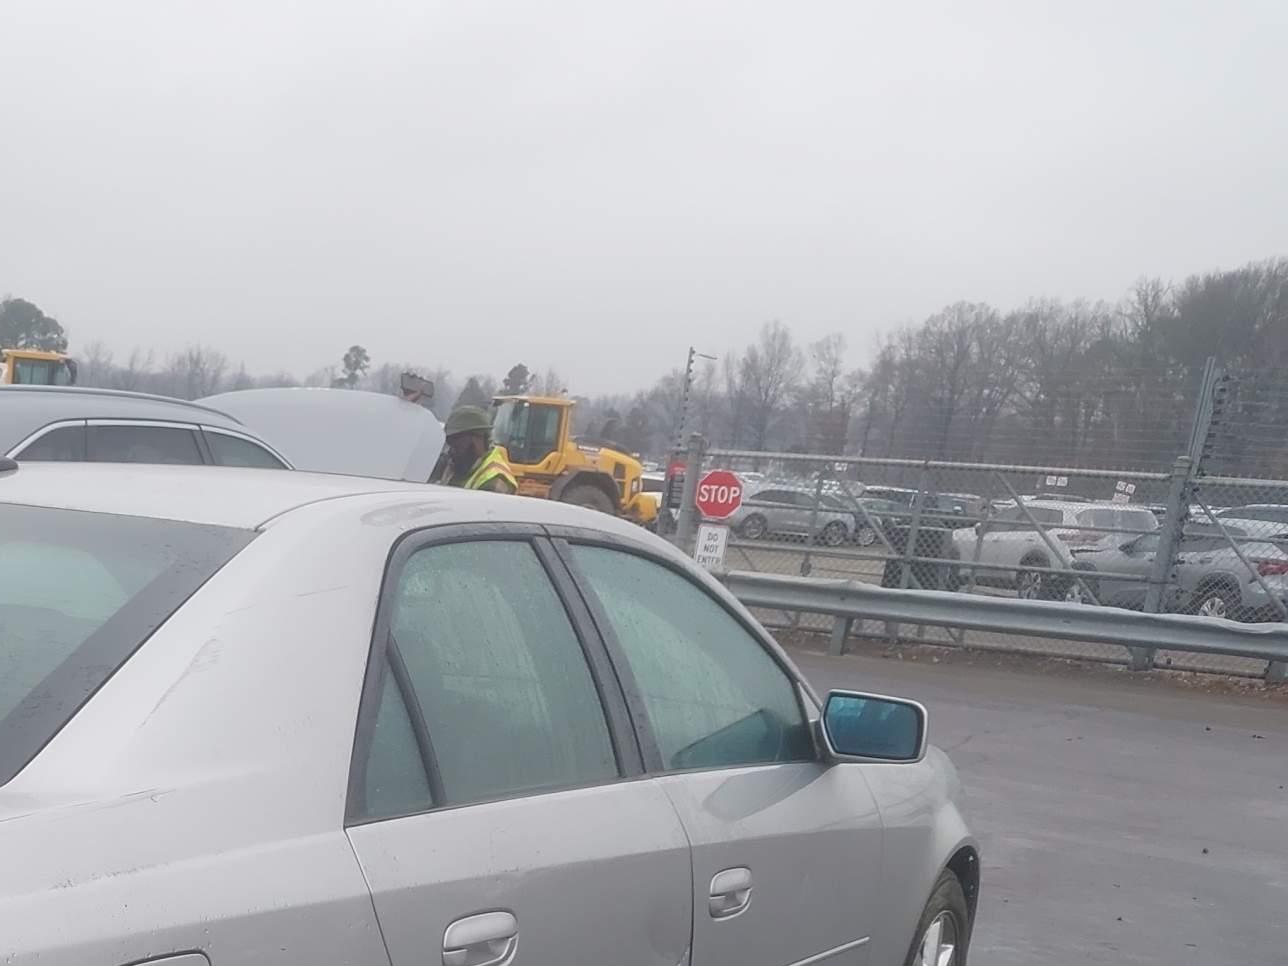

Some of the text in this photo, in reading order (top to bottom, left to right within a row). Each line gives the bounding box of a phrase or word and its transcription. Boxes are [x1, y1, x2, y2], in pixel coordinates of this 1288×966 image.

[699, 485, 740, 504] STOP
[707, 532, 719, 541] DO
[704, 544, 719, 553] NOT
